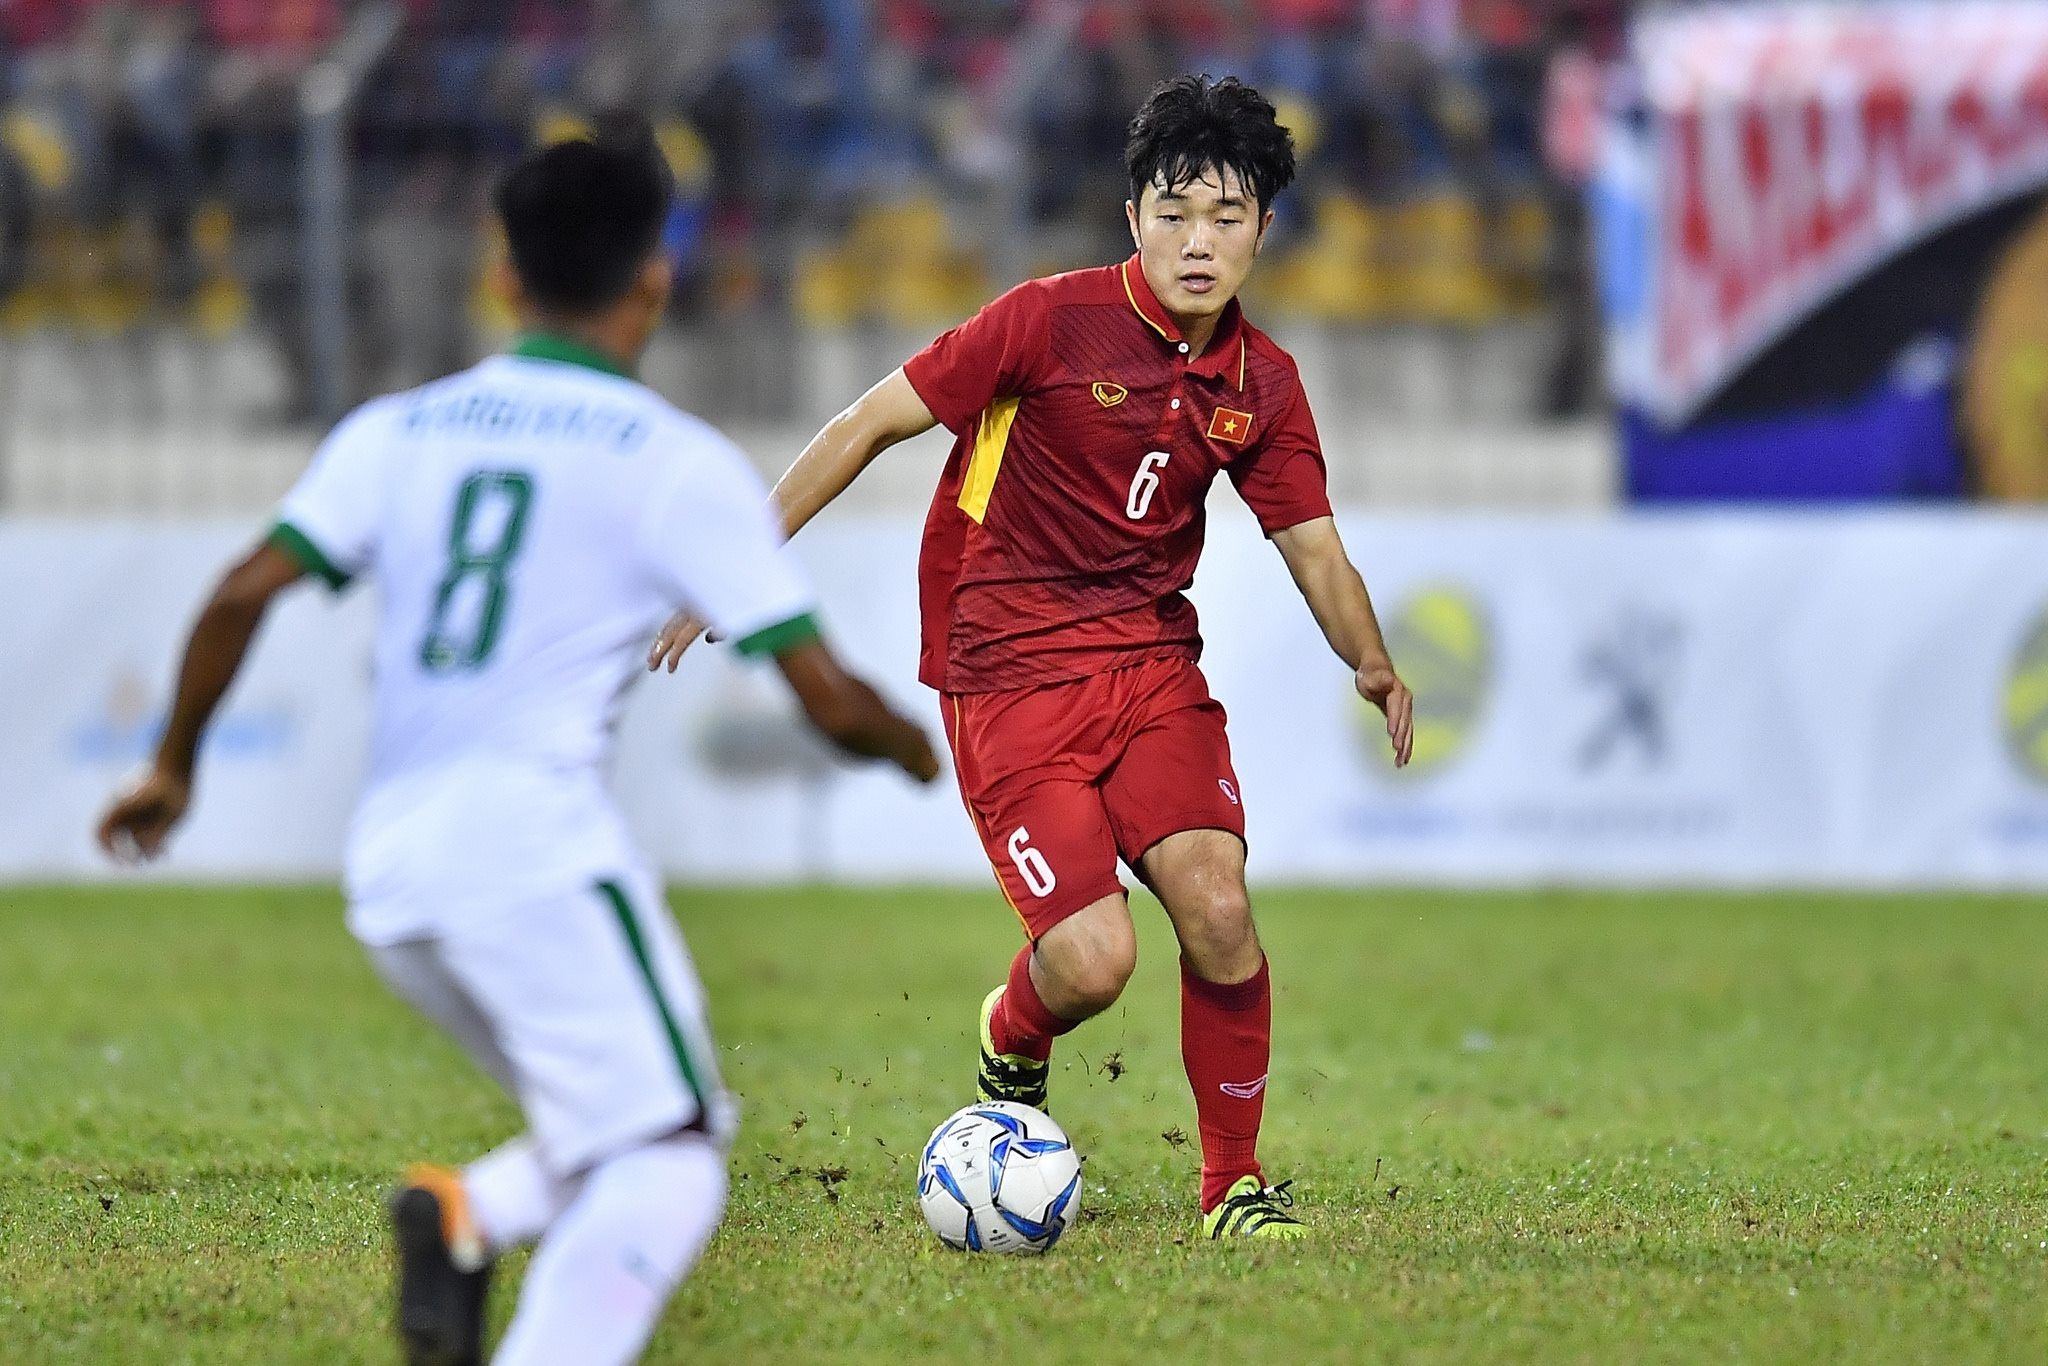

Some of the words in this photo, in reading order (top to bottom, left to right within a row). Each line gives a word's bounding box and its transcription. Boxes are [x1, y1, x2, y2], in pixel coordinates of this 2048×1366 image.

[1126, 451, 1170, 520] 6
[418, 468, 535, 671] 8
[1007, 825, 1056, 897] 6
